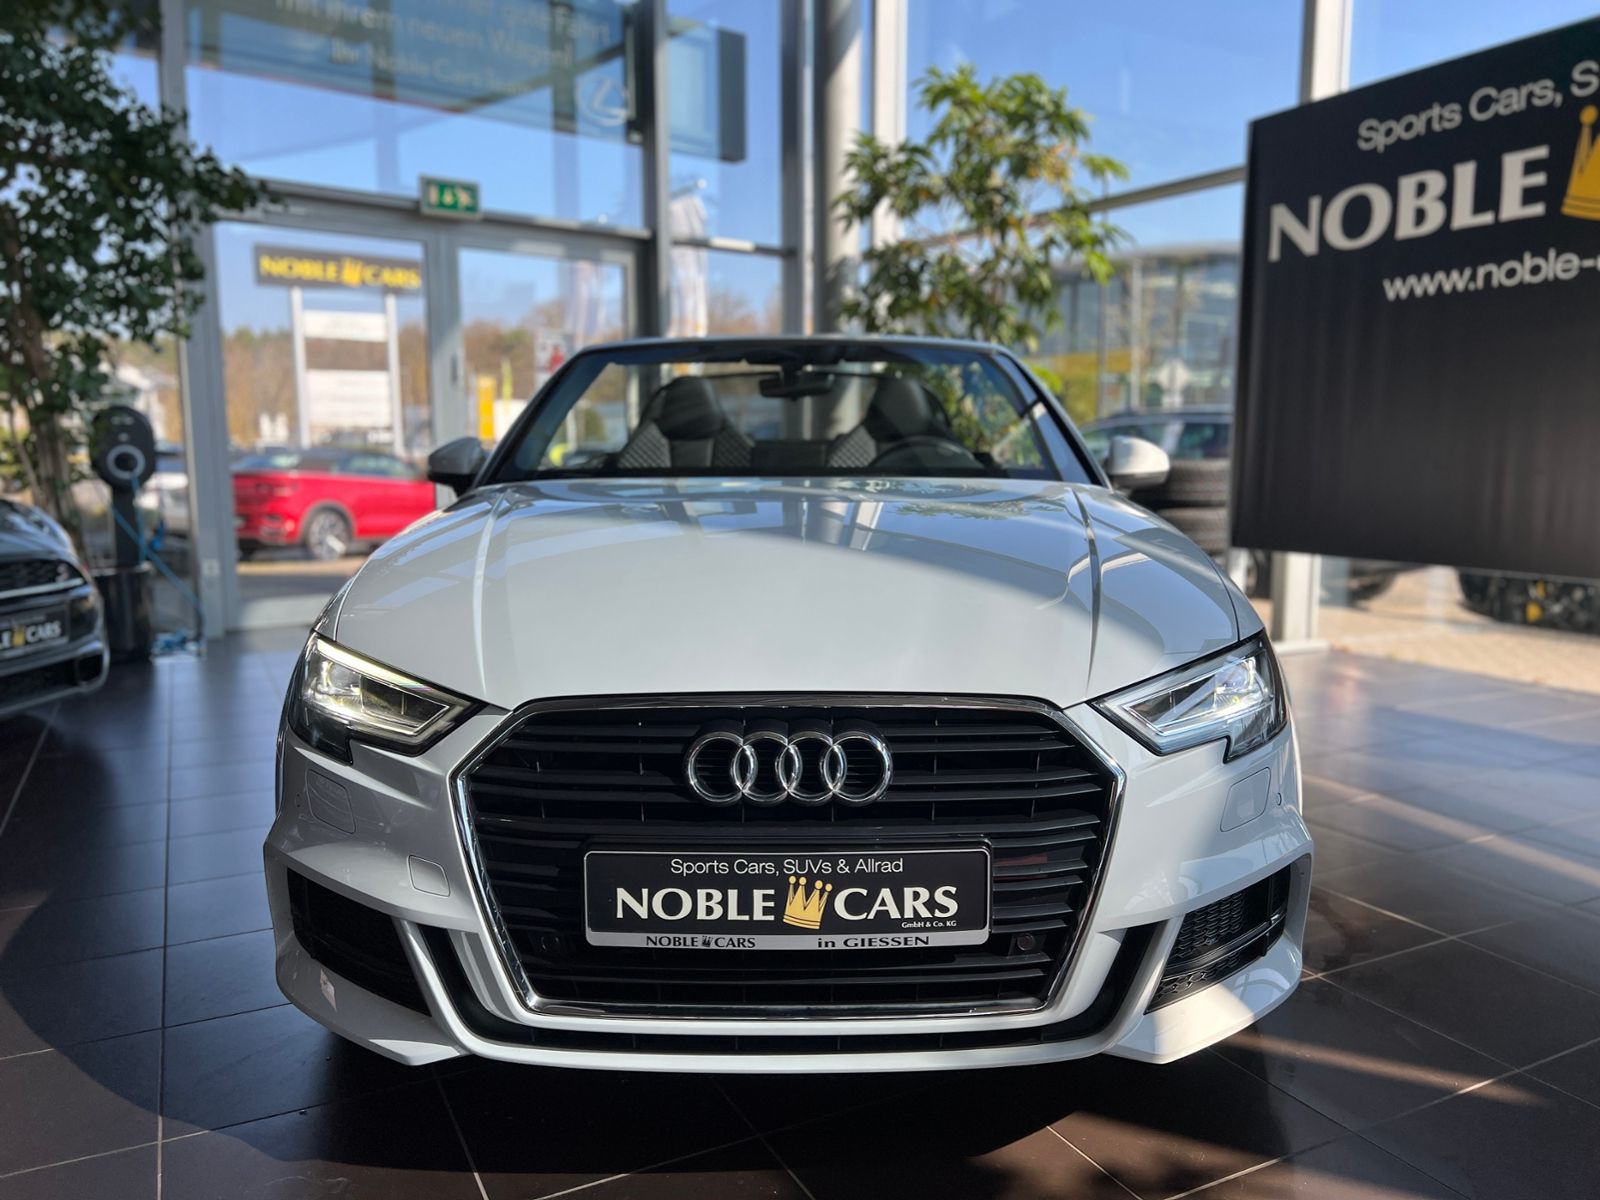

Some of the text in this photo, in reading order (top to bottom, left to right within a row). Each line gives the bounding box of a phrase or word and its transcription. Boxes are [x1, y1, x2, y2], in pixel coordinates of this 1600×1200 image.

[1357, 102, 1462, 152] Sports
[1469, 78, 1563, 122] Cars,
[1268, 144, 1550, 262] NOBLE
[259, 254, 421, 289] NOBLE CARS
[1383, 247, 1600, 302] www.noble-
[671, 858, 904, 876] Sports Cars, SUVs & Allrad
[616, 885, 959, 921] NOBLE CARS
[933, 920, 945, 928] Co.
[646, 936, 929, 948] NOBLE CARS in GIESSEN
